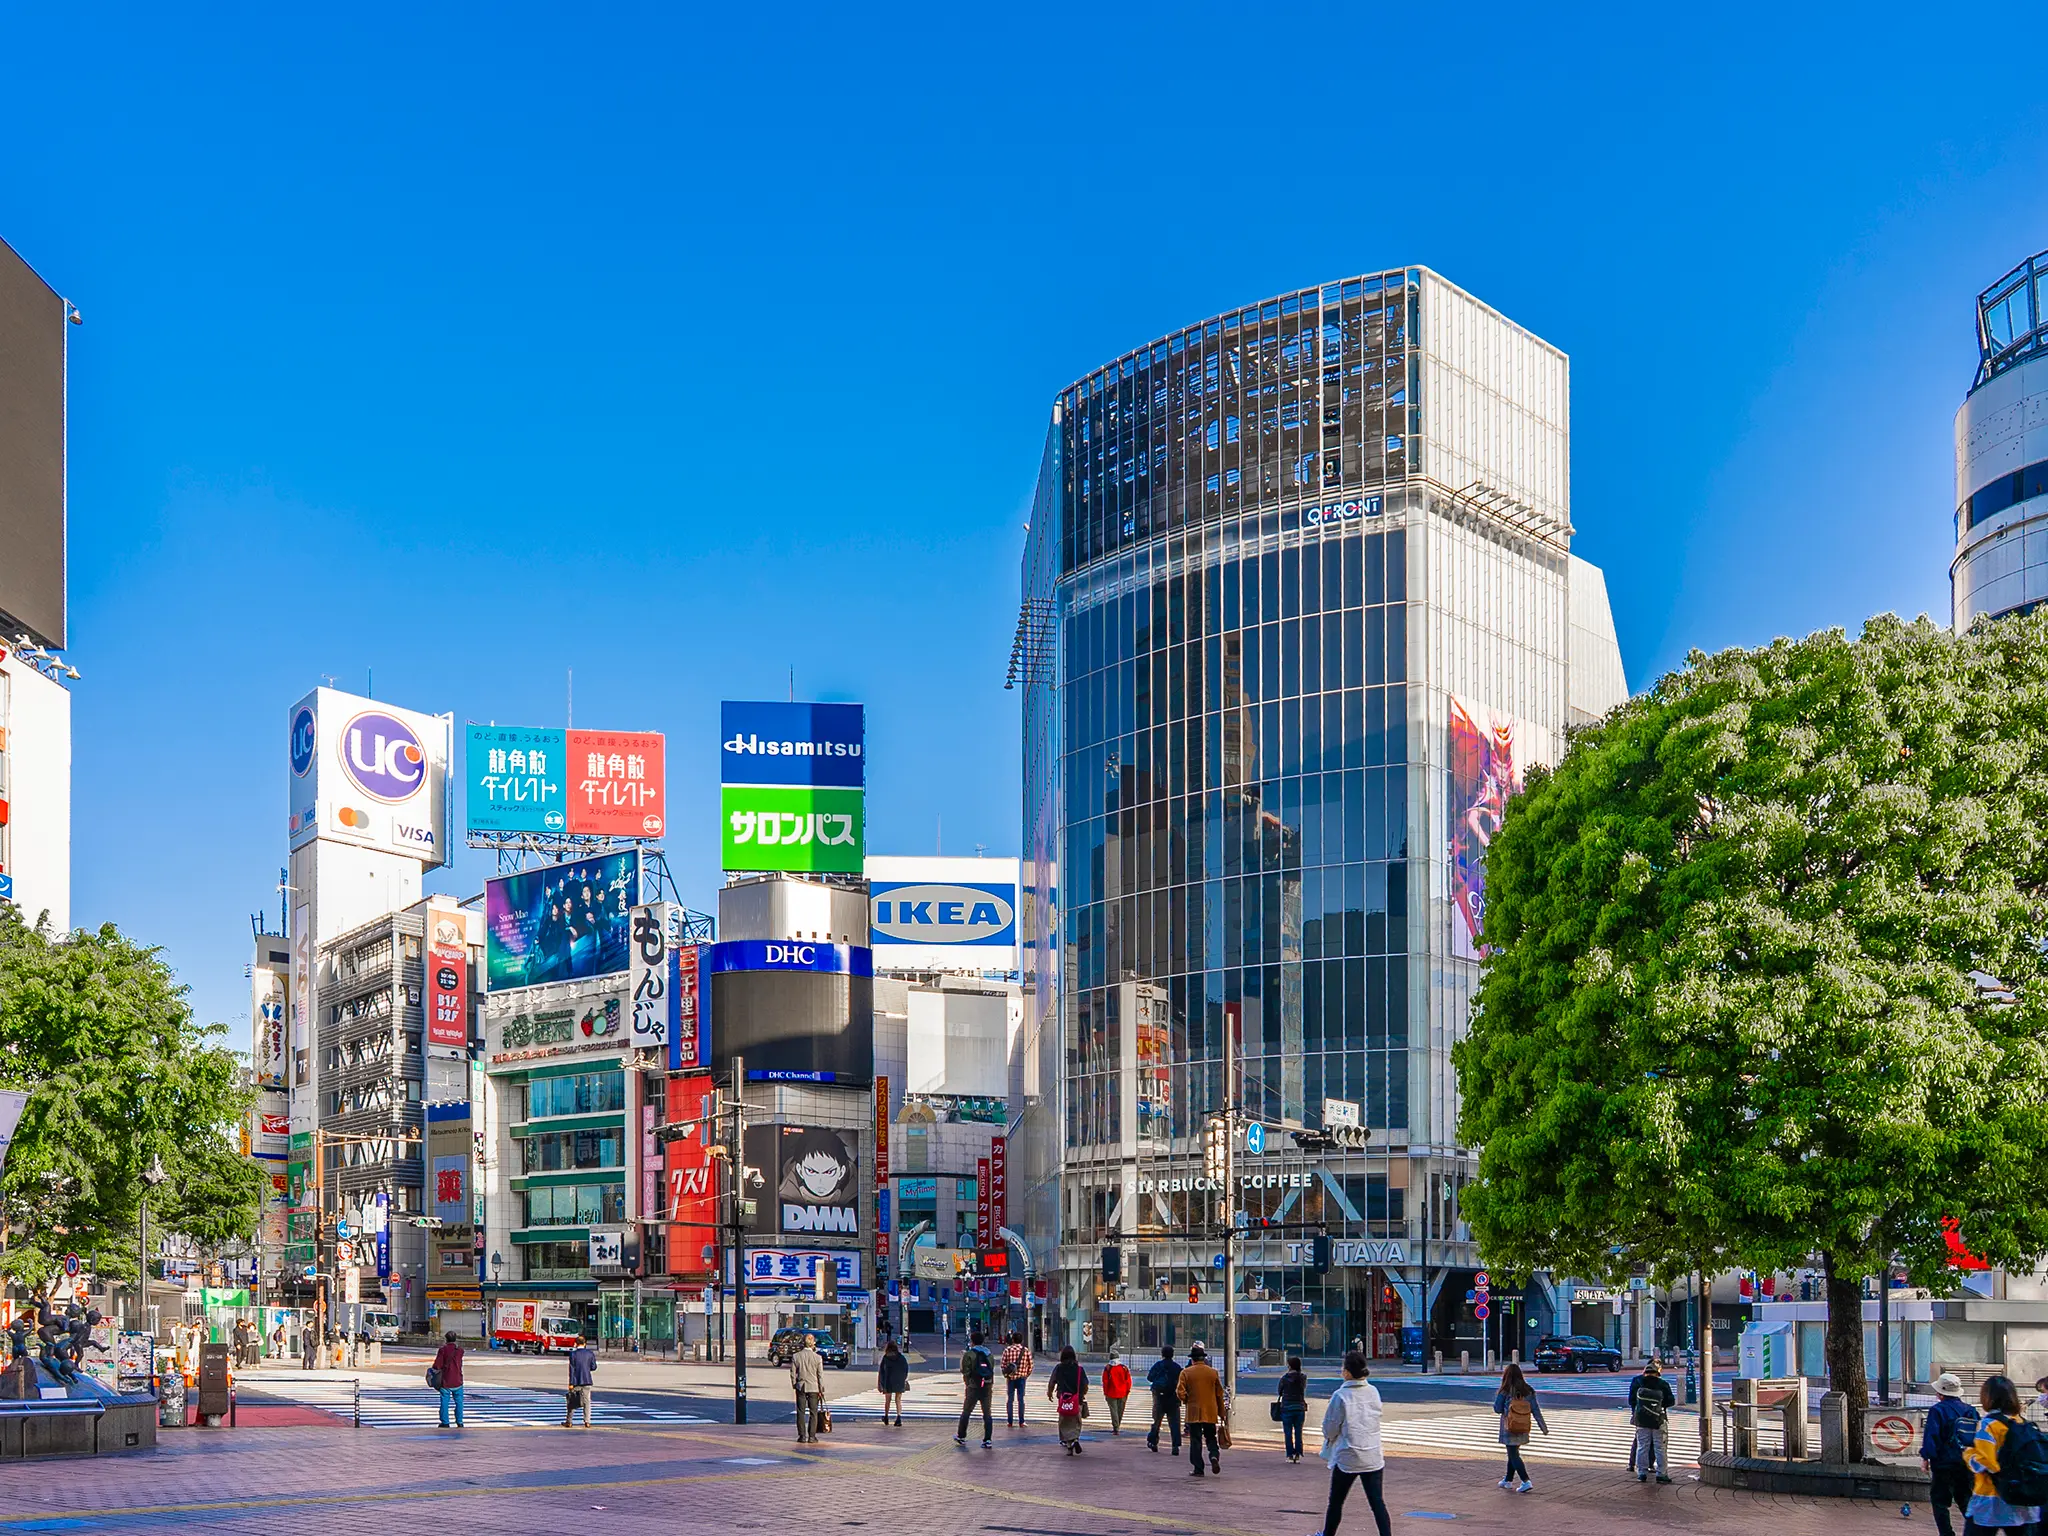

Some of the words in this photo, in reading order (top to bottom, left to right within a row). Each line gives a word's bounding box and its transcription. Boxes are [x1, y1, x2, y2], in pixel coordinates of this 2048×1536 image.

[1307, 497, 1380, 525] QFRONT
[351, 728, 421, 782] UC
[724, 734, 861, 756] Hisamitsu
[488, 748, 547, 775] 龍角散
[588, 752, 645, 779] 龍角散
[480, 775, 558, 802] ダイレクト
[579, 780, 657, 806] ダイレクト
[398, 824, 434, 844] VISA
[730, 811, 855, 846] サロンパス
[877, 901, 1002, 925] IKEA
[765, 945, 815, 965] DHC
[633, 907, 665, 1042] もんじゃ
[437, 993, 458, 1008] B1F
[680, 949, 695, 1061] 三千里薬品
[437, 1008, 459, 1022] B2F
[769, 1071, 785, 1079] DHC
[785, 1072, 815, 1080] Channel
[993, 1144, 1004, 1199] カラオケ
[1127, 1178, 1226, 1195] STARBUCKS
[1241, 1174, 1312, 1190] COFFEE
[670, 1153, 711, 1221] クスリ
[783, 1204, 858, 1233] DMM
[979, 1202, 988, 1249] カラオケ
[1287, 1242, 1405, 1263] TSTAYA
[1574, 1290, 1605, 1300] TSUTAYA
[502, 1316, 522, 1328] PRIME
